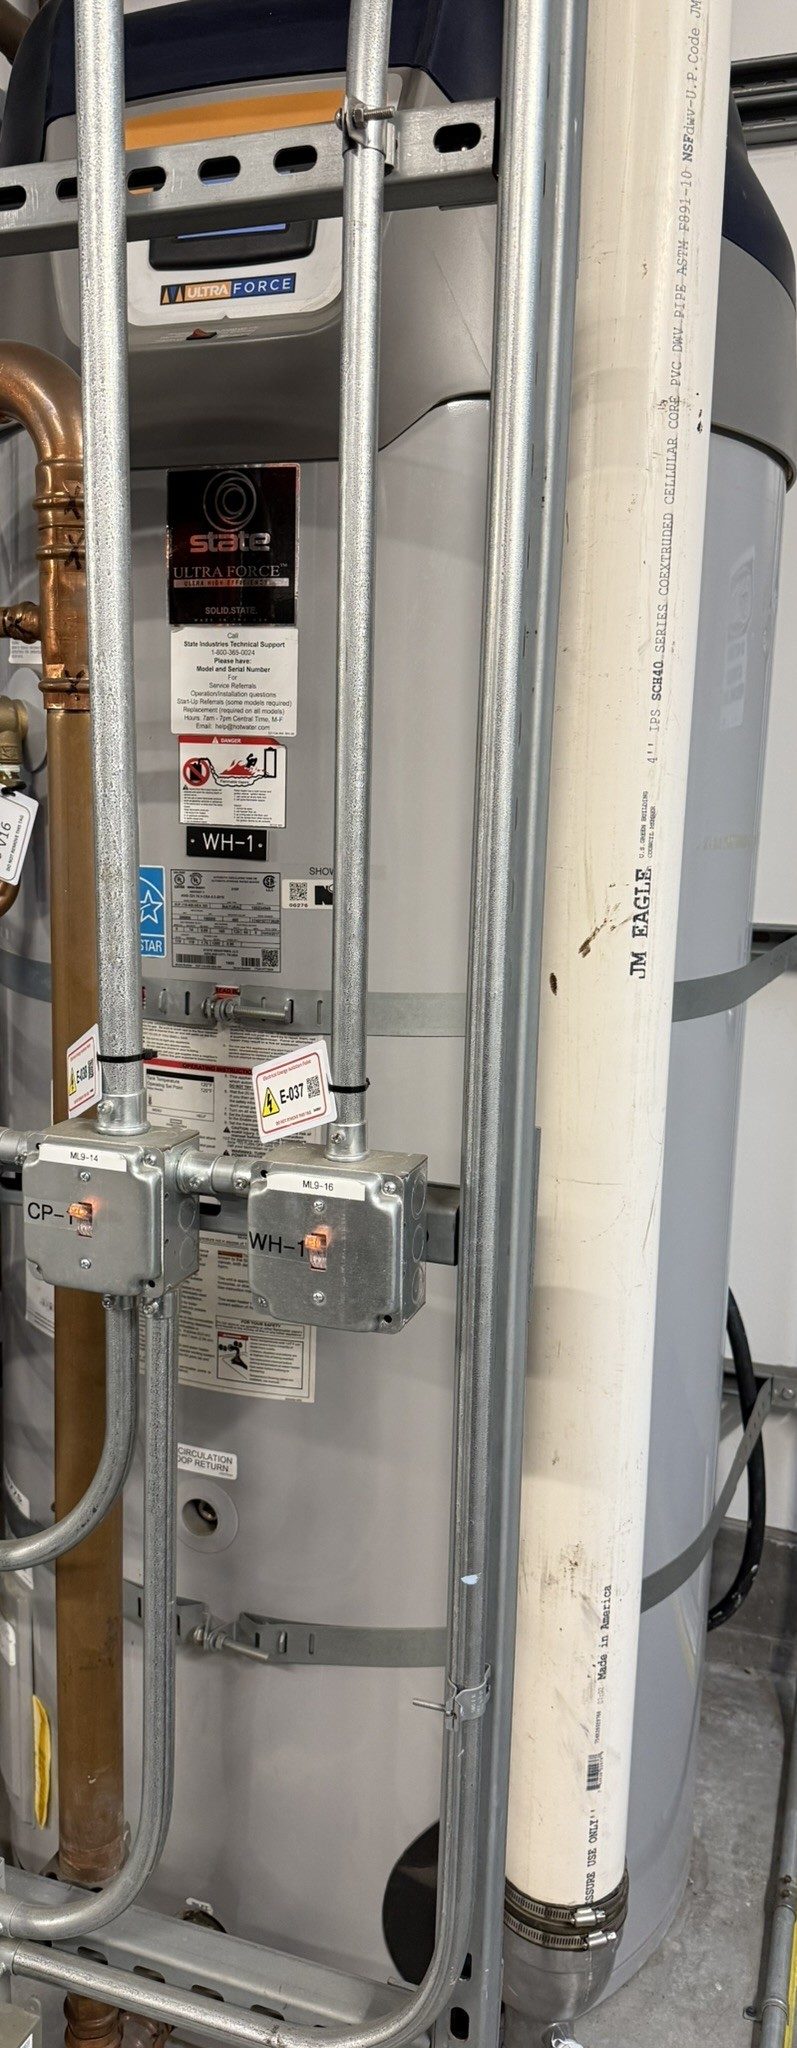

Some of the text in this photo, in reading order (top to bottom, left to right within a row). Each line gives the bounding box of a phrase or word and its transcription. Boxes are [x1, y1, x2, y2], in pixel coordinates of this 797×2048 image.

[679, 170, 692, 232] F891-10
[677, 239, 688, 276] ASTM
[233, 278, 292, 294] FORCE
[674, 284, 686, 319] PIPE
[672, 327, 684, 352] DWV
[670, 361, 682, 386] PVC
[668, 396, 680, 430] CORE
[664, 437, 678, 504] CELLULAR
[190, 531, 271, 552] state
[658, 512, 674, 596] COEXTRUDED
[174, 566, 223, 578] ULTRA
[655, 604, 668, 654] SERIES
[652, 660, 664, 701] SCH40
[650, 708, 660, 732] IPS
[203, 833, 253, 852] WH-1
[630, 868, 652, 979] JM EAGLE
[280, 1083, 304, 1104] E-037
[70, 1152, 98, 1161] ML9-14
[302, 1180, 334, 1191] ML9-16
[250, 1231, 304, 1257] WH-1
[195, 1459, 229, 1472] RETURN
[600, 1585, 611, 1630] America
[599, 1635, 608, 1648] in
[597, 1654, 607, 1680] Made
[587, 1848, 596, 1867] USE
